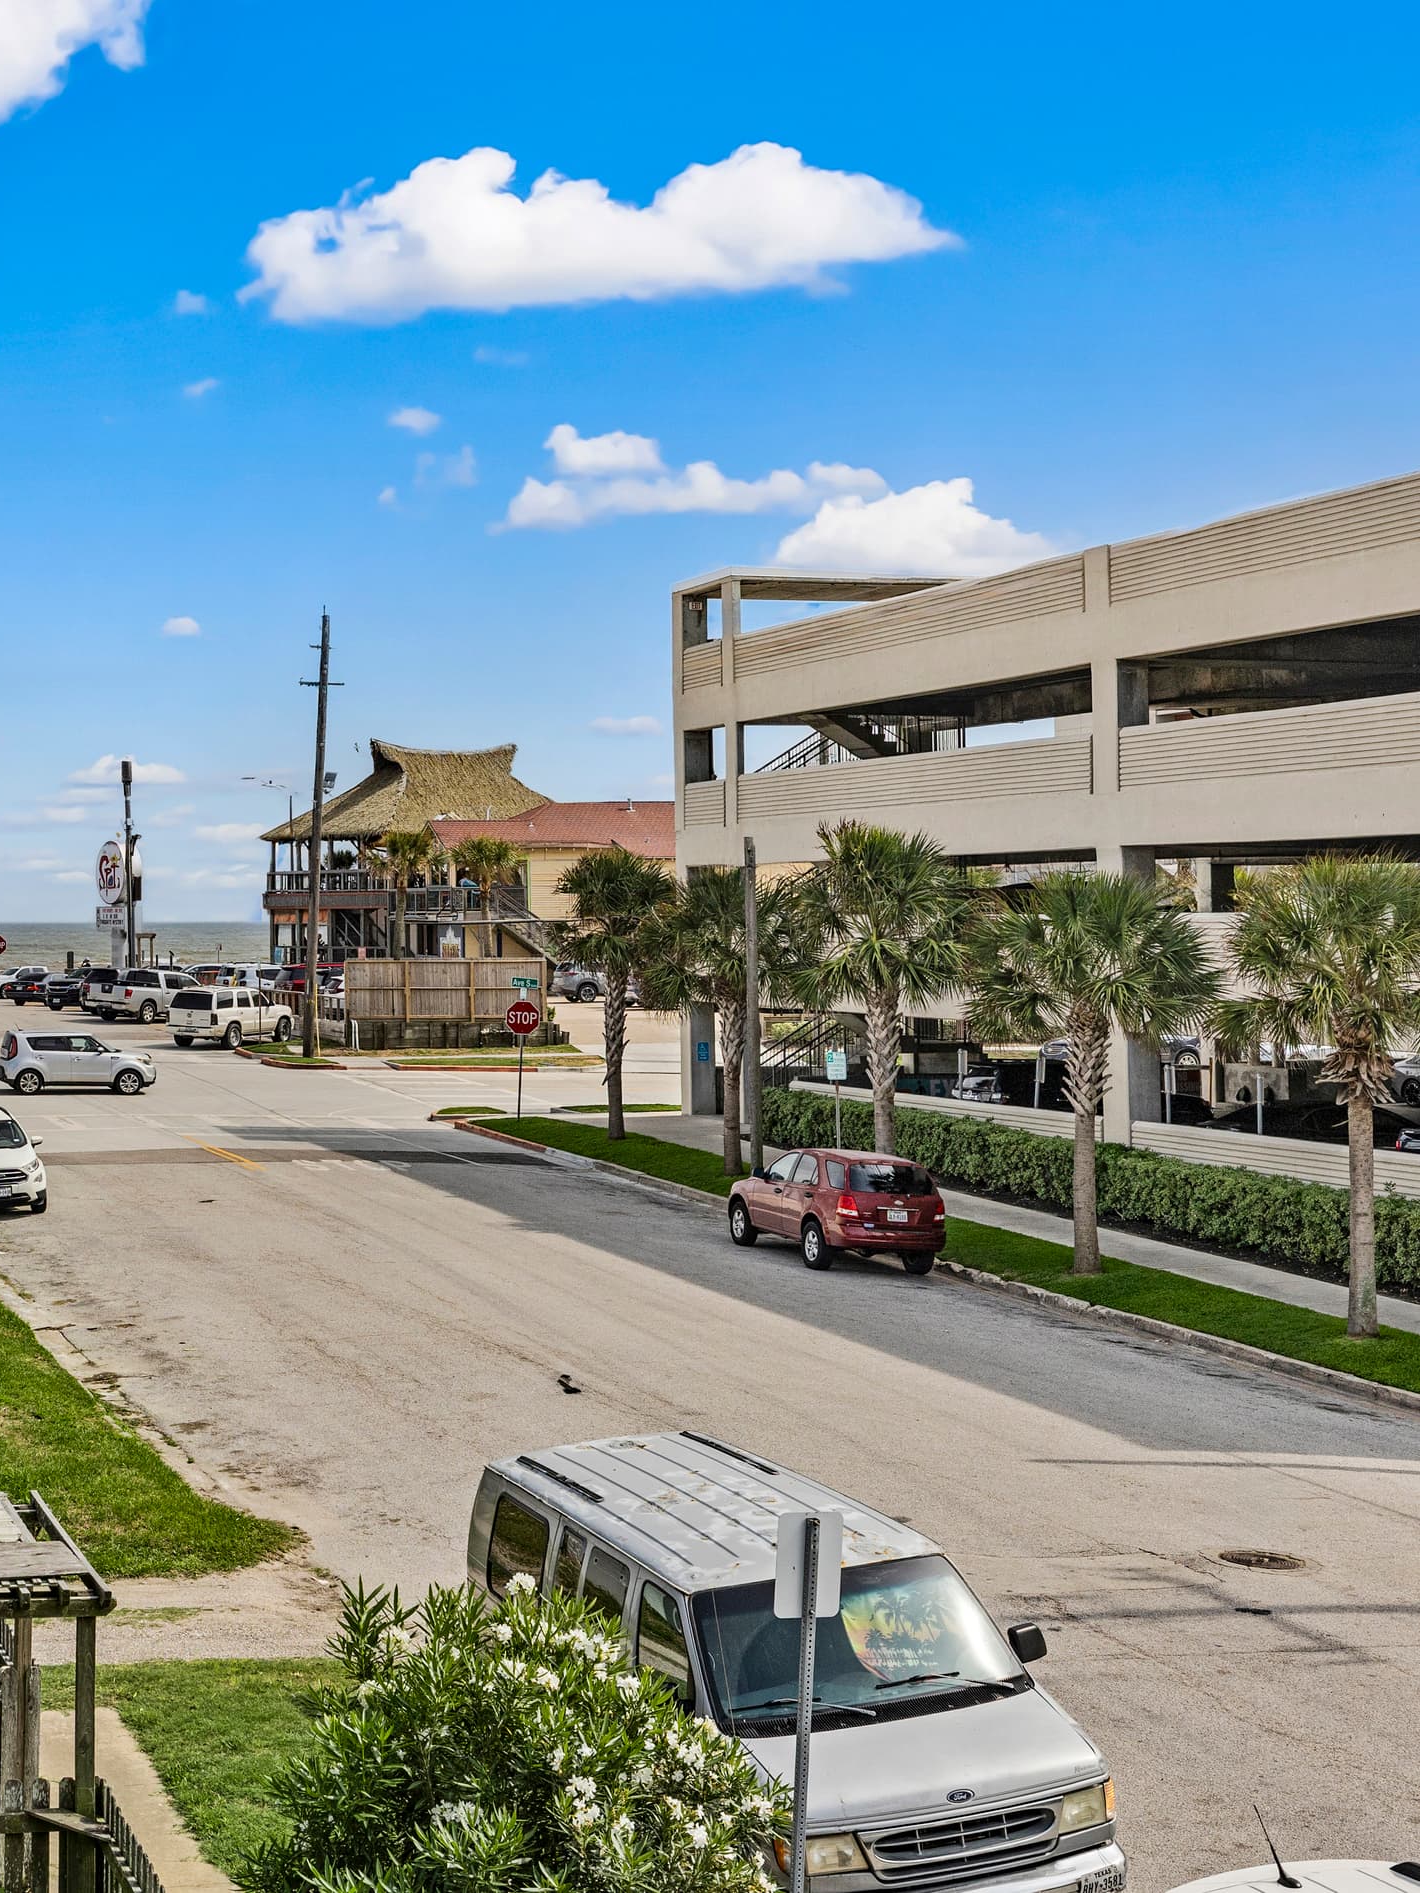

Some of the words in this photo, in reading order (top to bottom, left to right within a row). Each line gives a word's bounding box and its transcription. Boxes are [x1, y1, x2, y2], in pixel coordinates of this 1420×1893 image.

[513, 978, 525, 986] Ave
[525, 979, 531, 988] S
[508, 1011, 538, 1025] STOP
[1094, 1868, 1112, 1879] TEXAS
